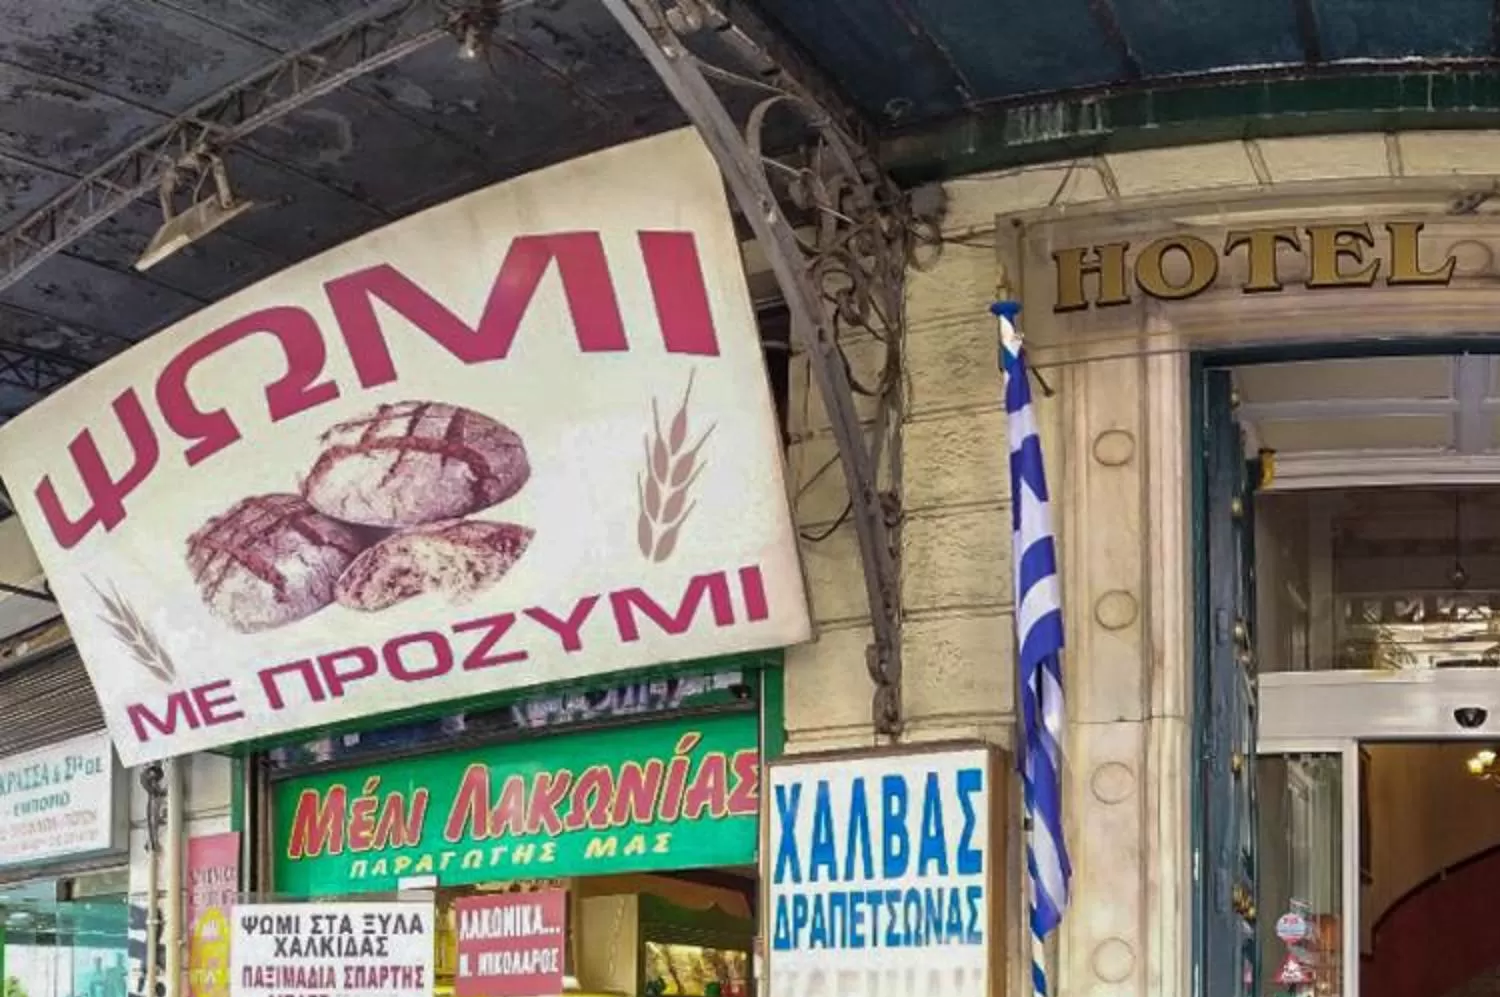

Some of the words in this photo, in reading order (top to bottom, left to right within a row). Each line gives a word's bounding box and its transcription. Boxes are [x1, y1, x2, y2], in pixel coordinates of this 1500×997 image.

[1051, 222, 1457, 314] HOTEL
[34, 230, 721, 551] ΨΩΜΙ
[125, 680, 245, 743] ΜΕ
[259, 565, 770, 710] ΠΡΟΖΥΜΙ
[349, 840, 557, 879] ΠΑΡΑΓΩΓΗΣ
[584, 832, 672, 860] ΜΑΣ
[774, 769, 983, 885] ΧΑΛΒΑΣ
[241, 915, 300, 935] ΨΩΜΙ
[312, 914, 353, 935] ΣΤΑ
[362, 914, 424, 935] ΞΥΛΑ
[274, 936, 389, 957] ΧΑΛΚΙΔΑΣ
[774, 886, 983, 950] ΔΡΑΠΕΤΣΩΝΑΣ
[242, 965, 337, 989] ΠΑΞΙΜΑΔΙΑ
[343, 965, 425, 989] ΣΠΑΡΤΗΣ
